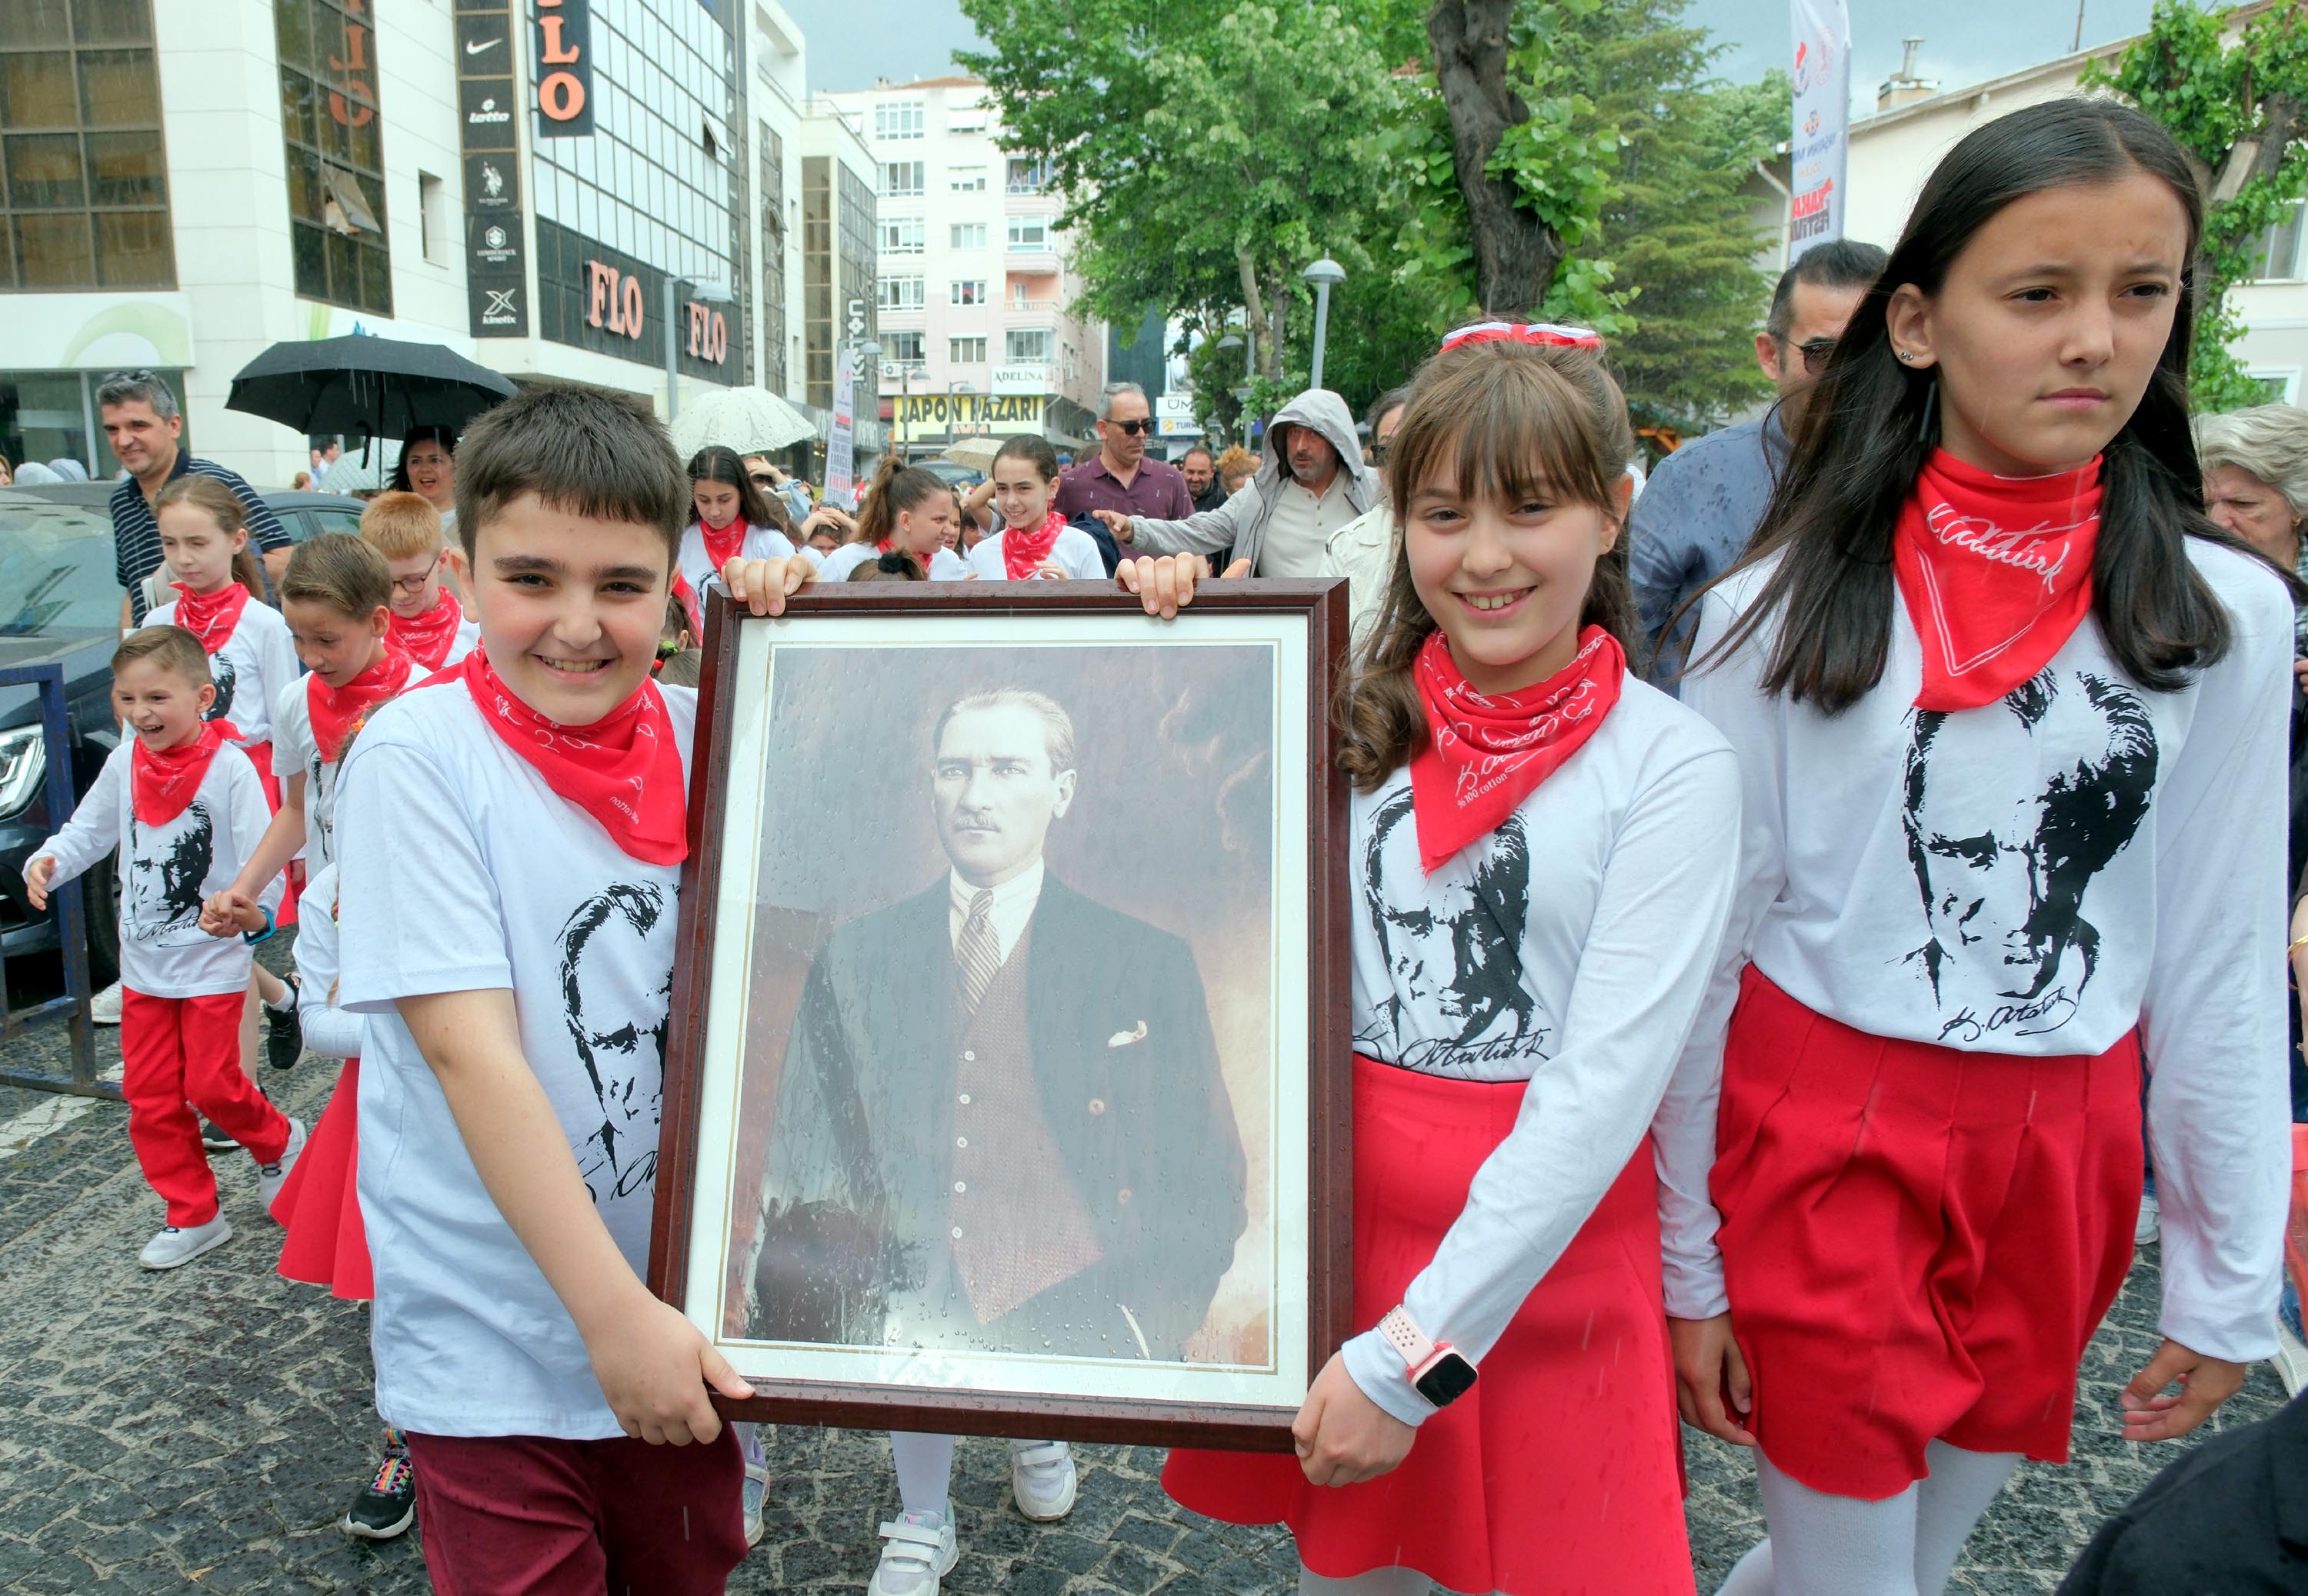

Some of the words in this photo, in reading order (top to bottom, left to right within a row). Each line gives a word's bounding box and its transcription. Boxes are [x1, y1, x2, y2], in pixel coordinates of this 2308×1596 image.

[537, 0, 585, 122] LO
[482, 315, 517, 325] kinetix
[586, 260, 643, 340] FLO
[687, 302, 727, 365] FLO
[970, 396, 1038, 421] PAZARI
[1457, 789, 1479, 808] %100
[1479, 772, 1508, 794] cotton
